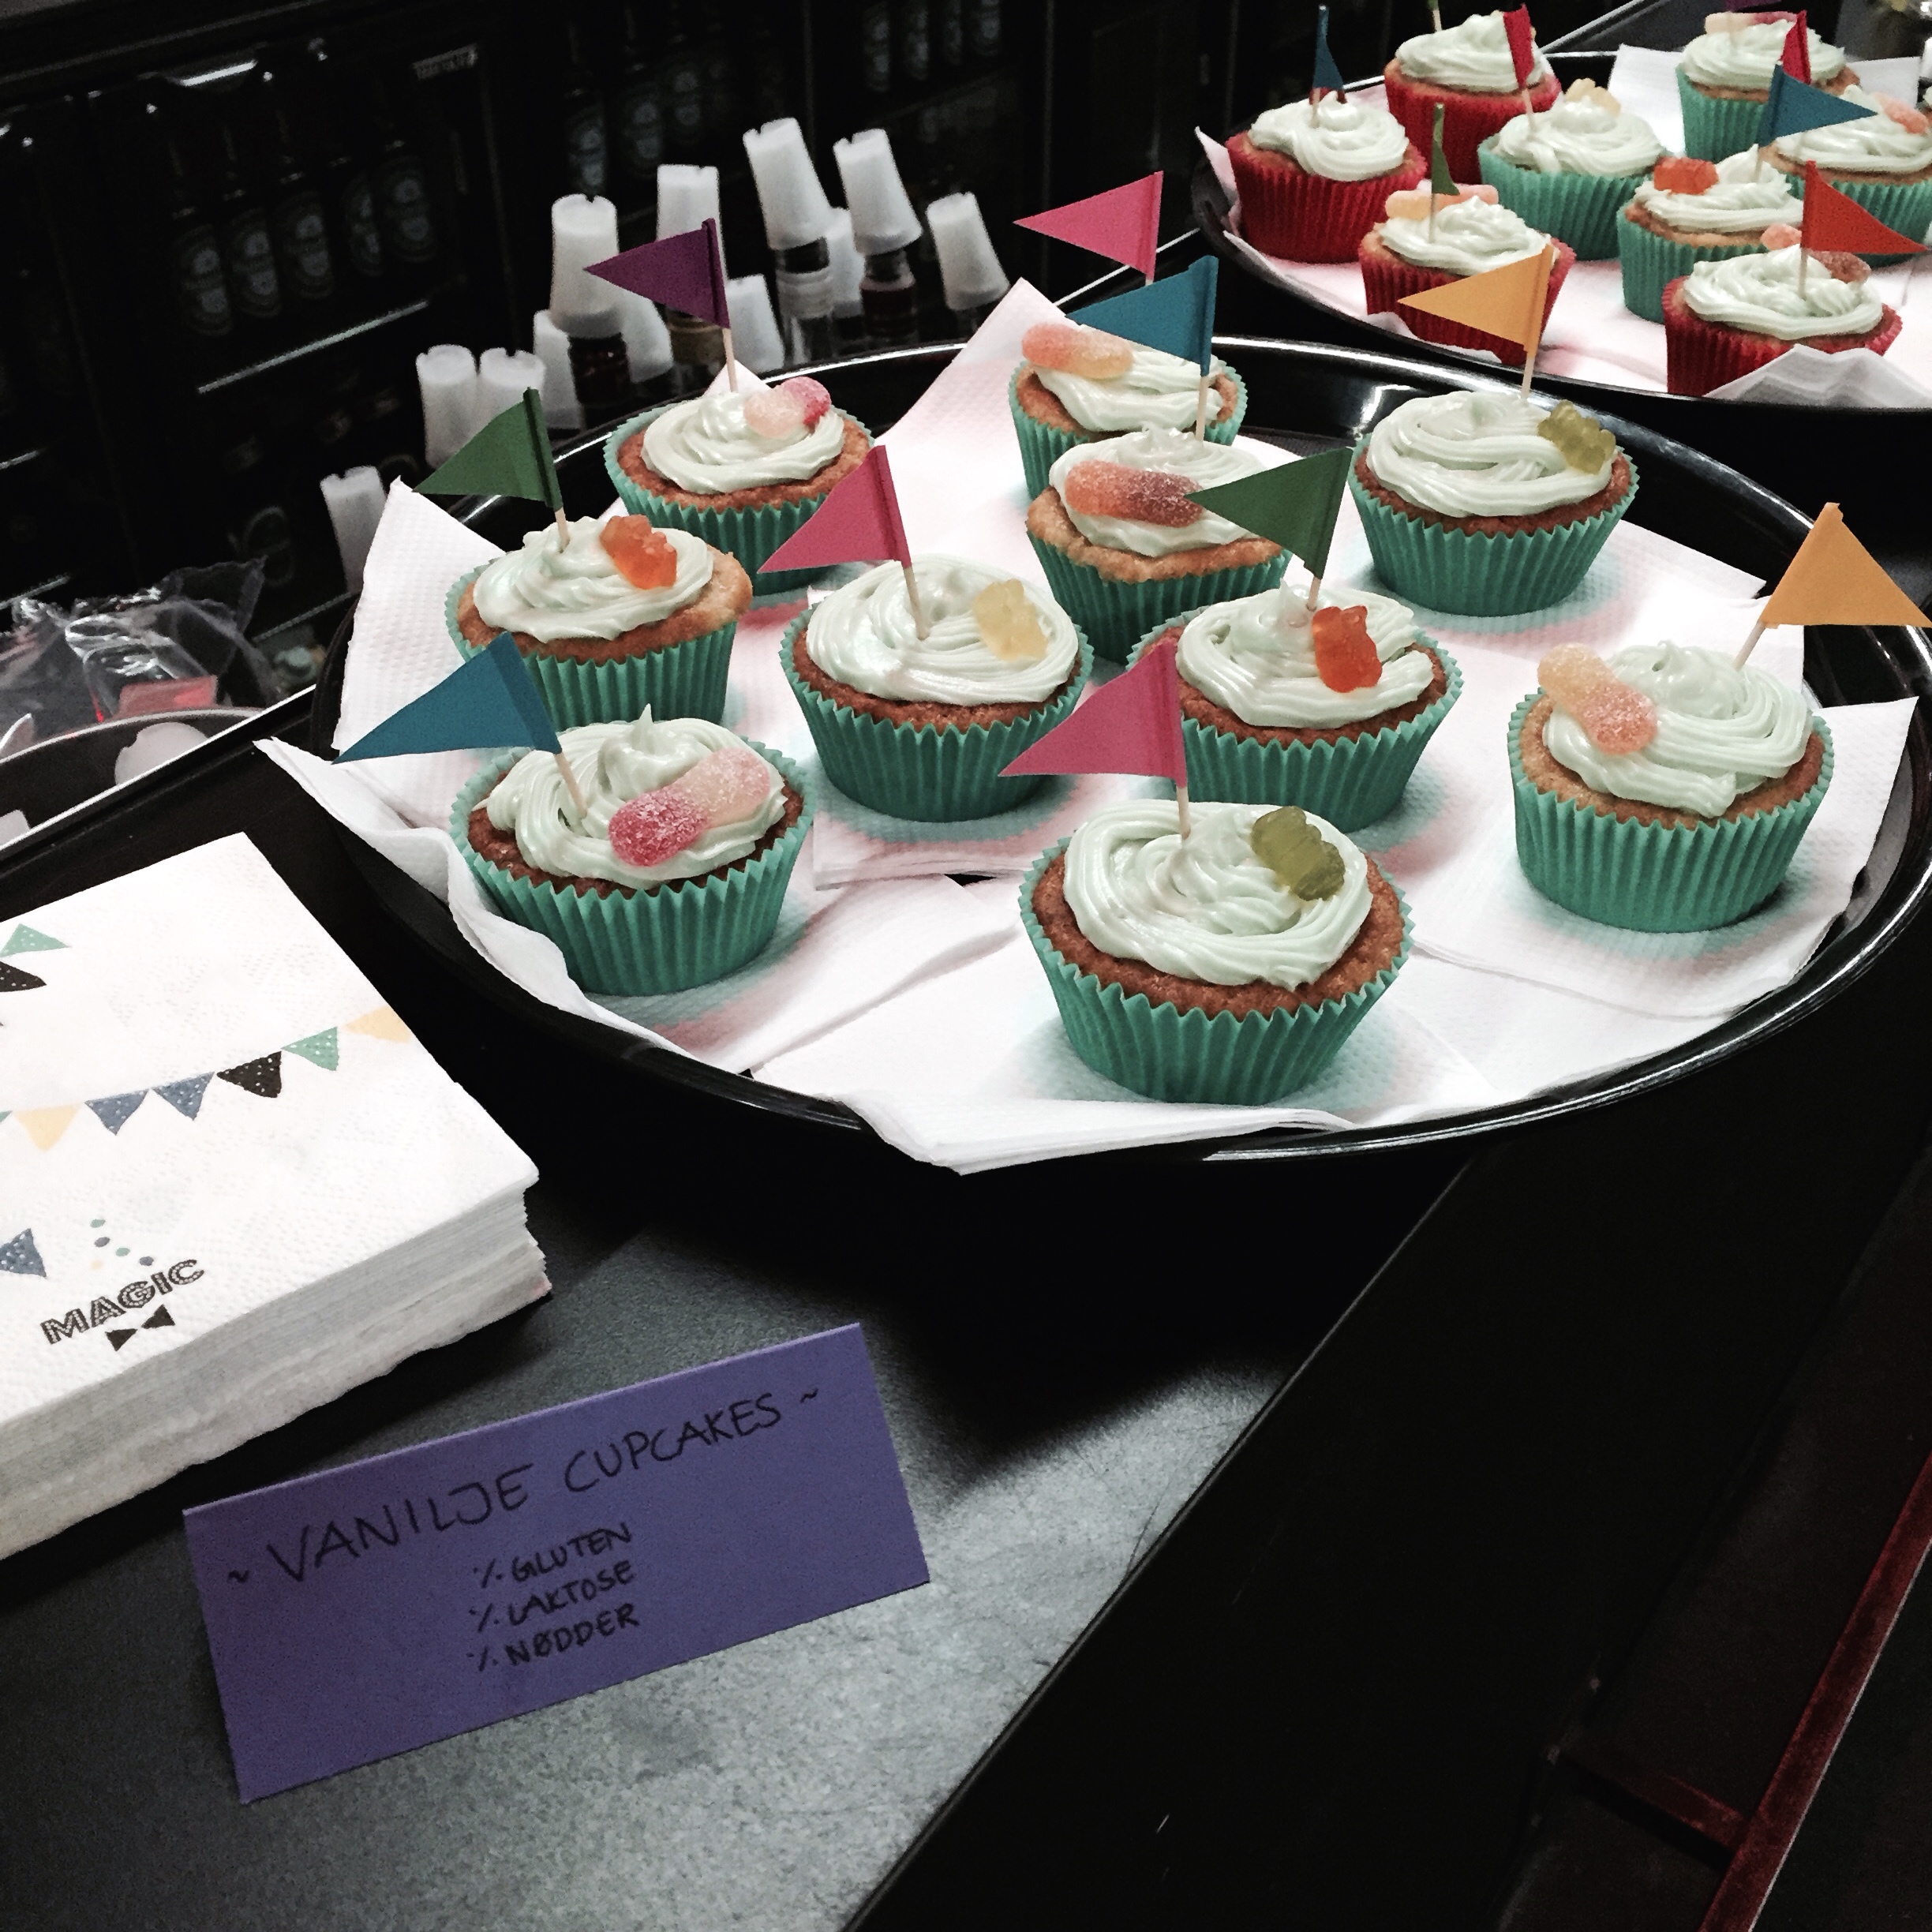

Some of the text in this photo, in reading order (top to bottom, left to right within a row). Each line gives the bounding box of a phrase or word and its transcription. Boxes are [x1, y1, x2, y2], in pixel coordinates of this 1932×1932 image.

[40, 1259, 204, 1344] MAGIC
[266, 1463, 535, 1582] VANILJE
[564, 1392, 781, 1492] CUPCAKES
[511, 1522, 631, 1582] GLUTEN
[508, 1559, 635, 1626] LAKTOSE
[504, 1603, 640, 1666] NØDDER
